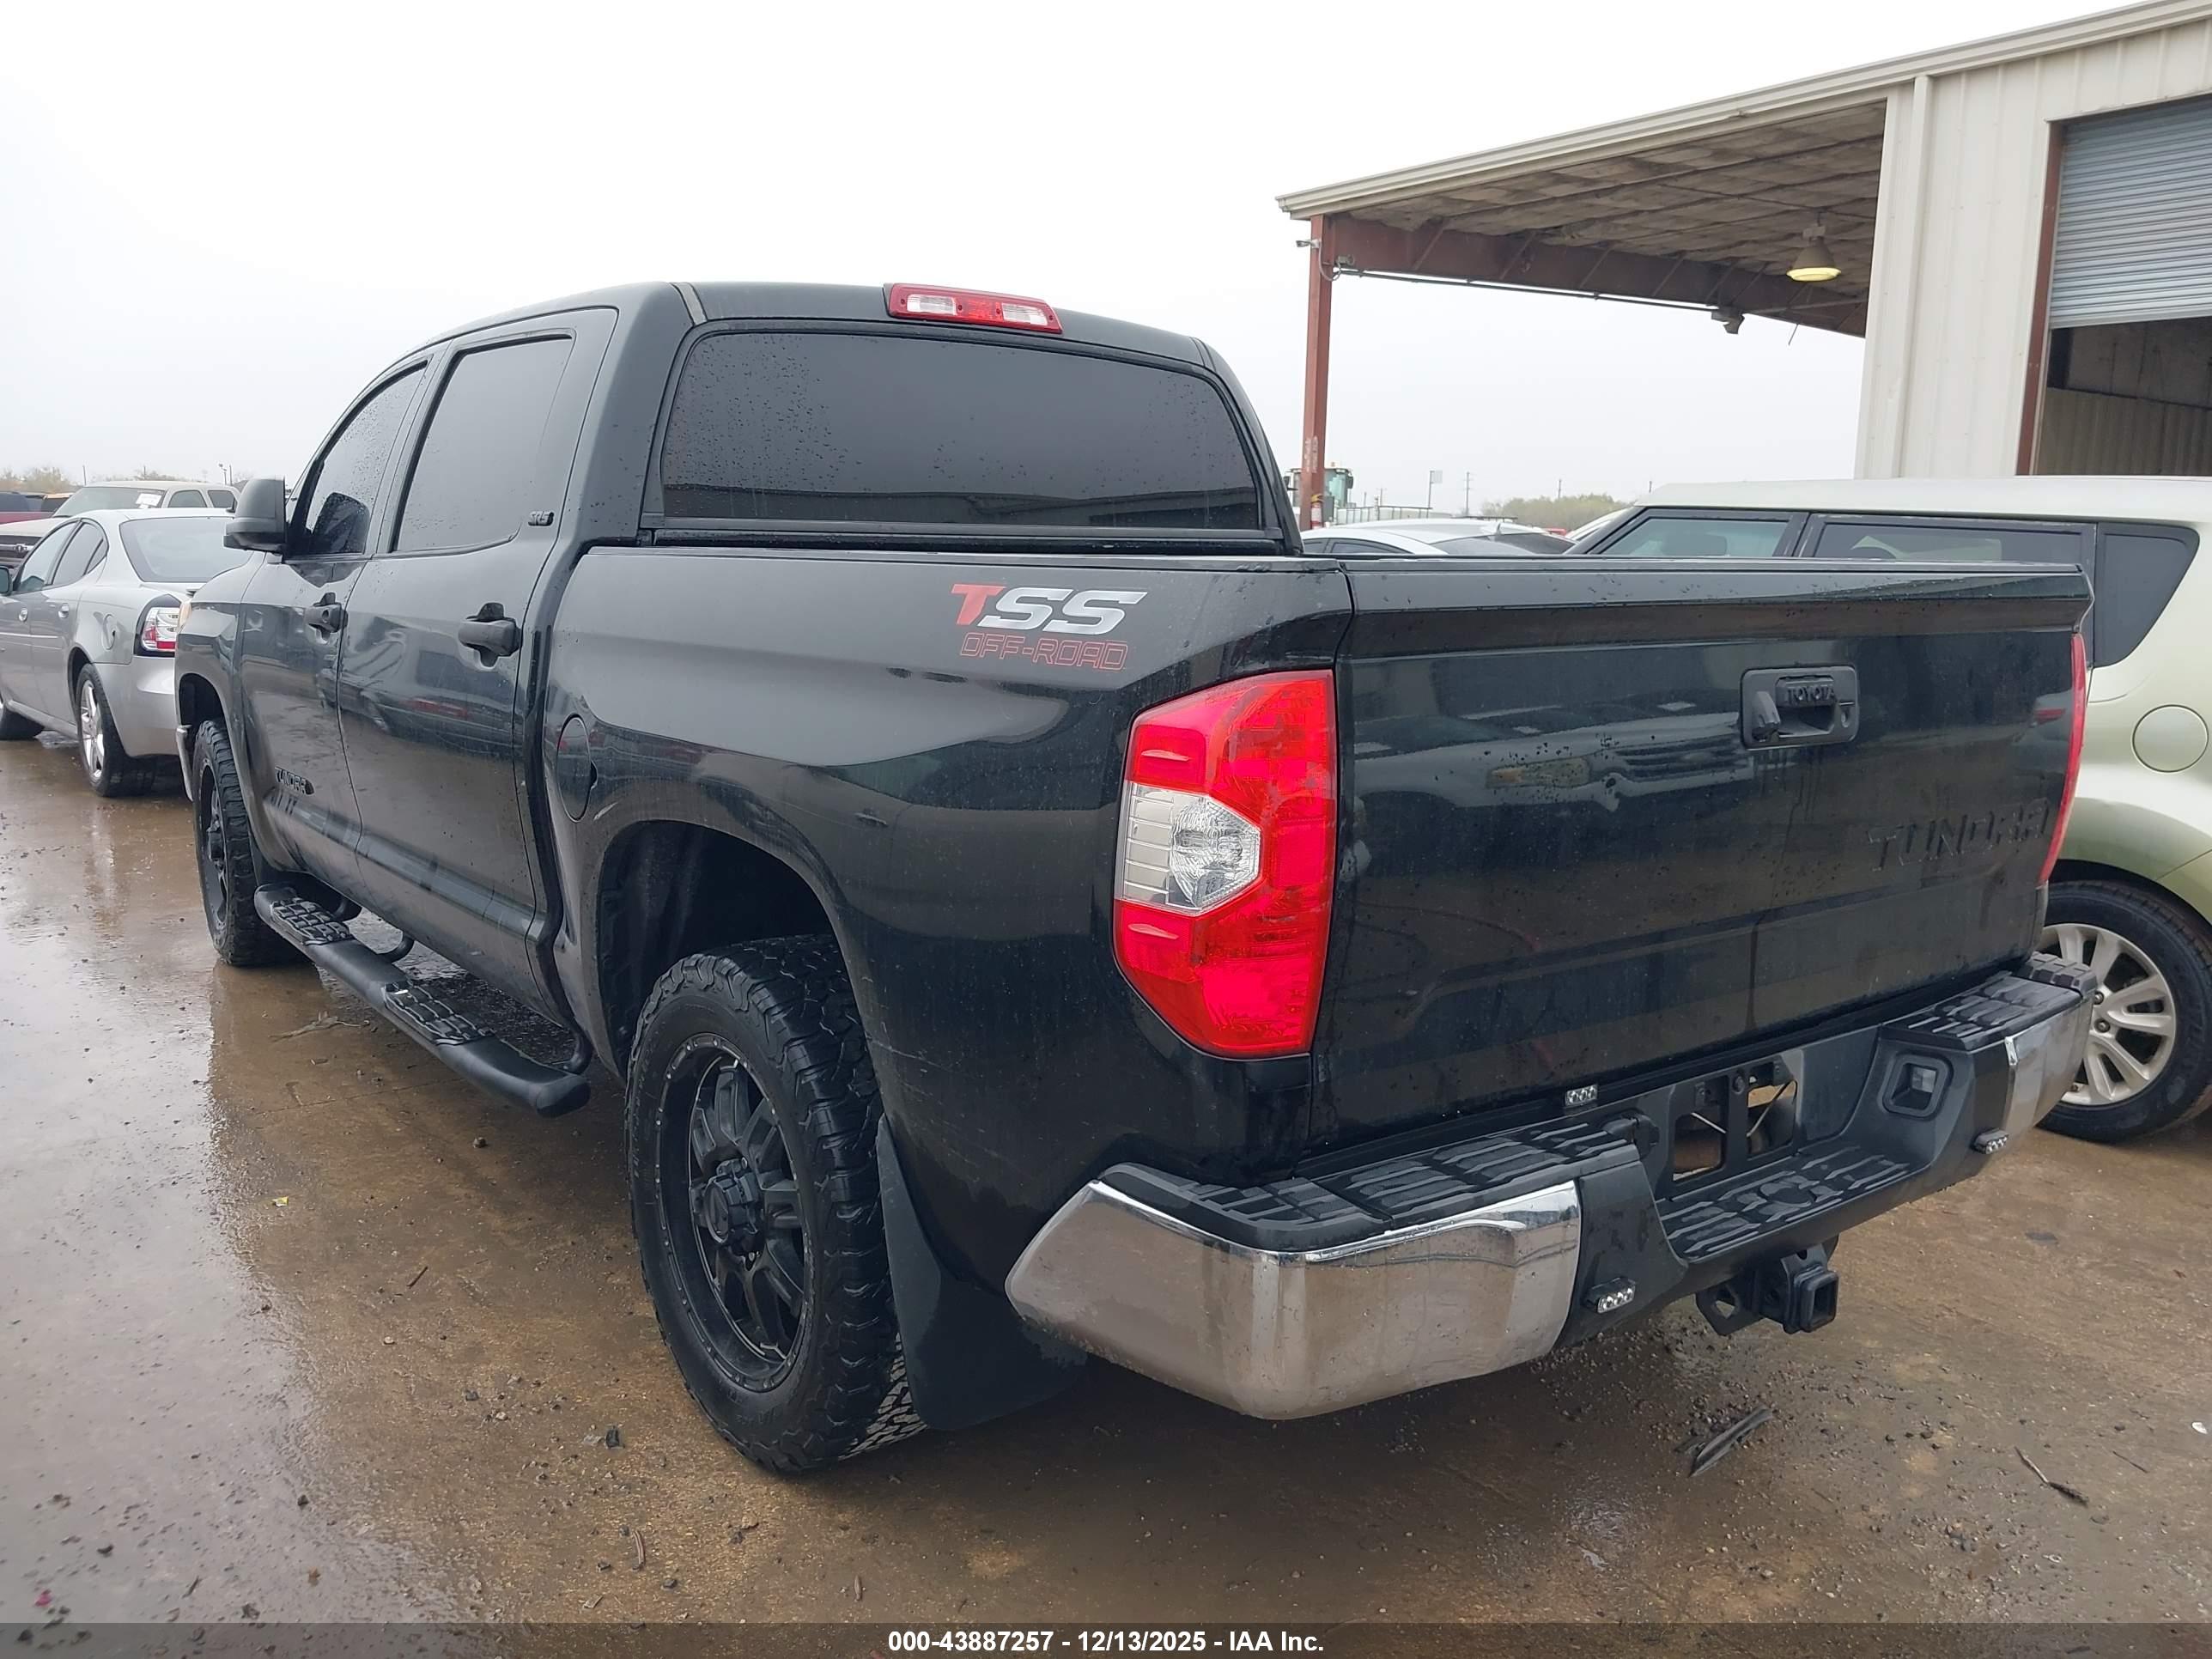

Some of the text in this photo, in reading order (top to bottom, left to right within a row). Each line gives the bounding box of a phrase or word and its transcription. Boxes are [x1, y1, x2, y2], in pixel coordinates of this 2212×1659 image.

[951, 583, 1148, 635] TSS
[960, 631, 1129, 672] OFF-ROAD
[1786, 685, 1837, 706] TOYOTA
[1865, 797, 2050, 872] TUNDRA
